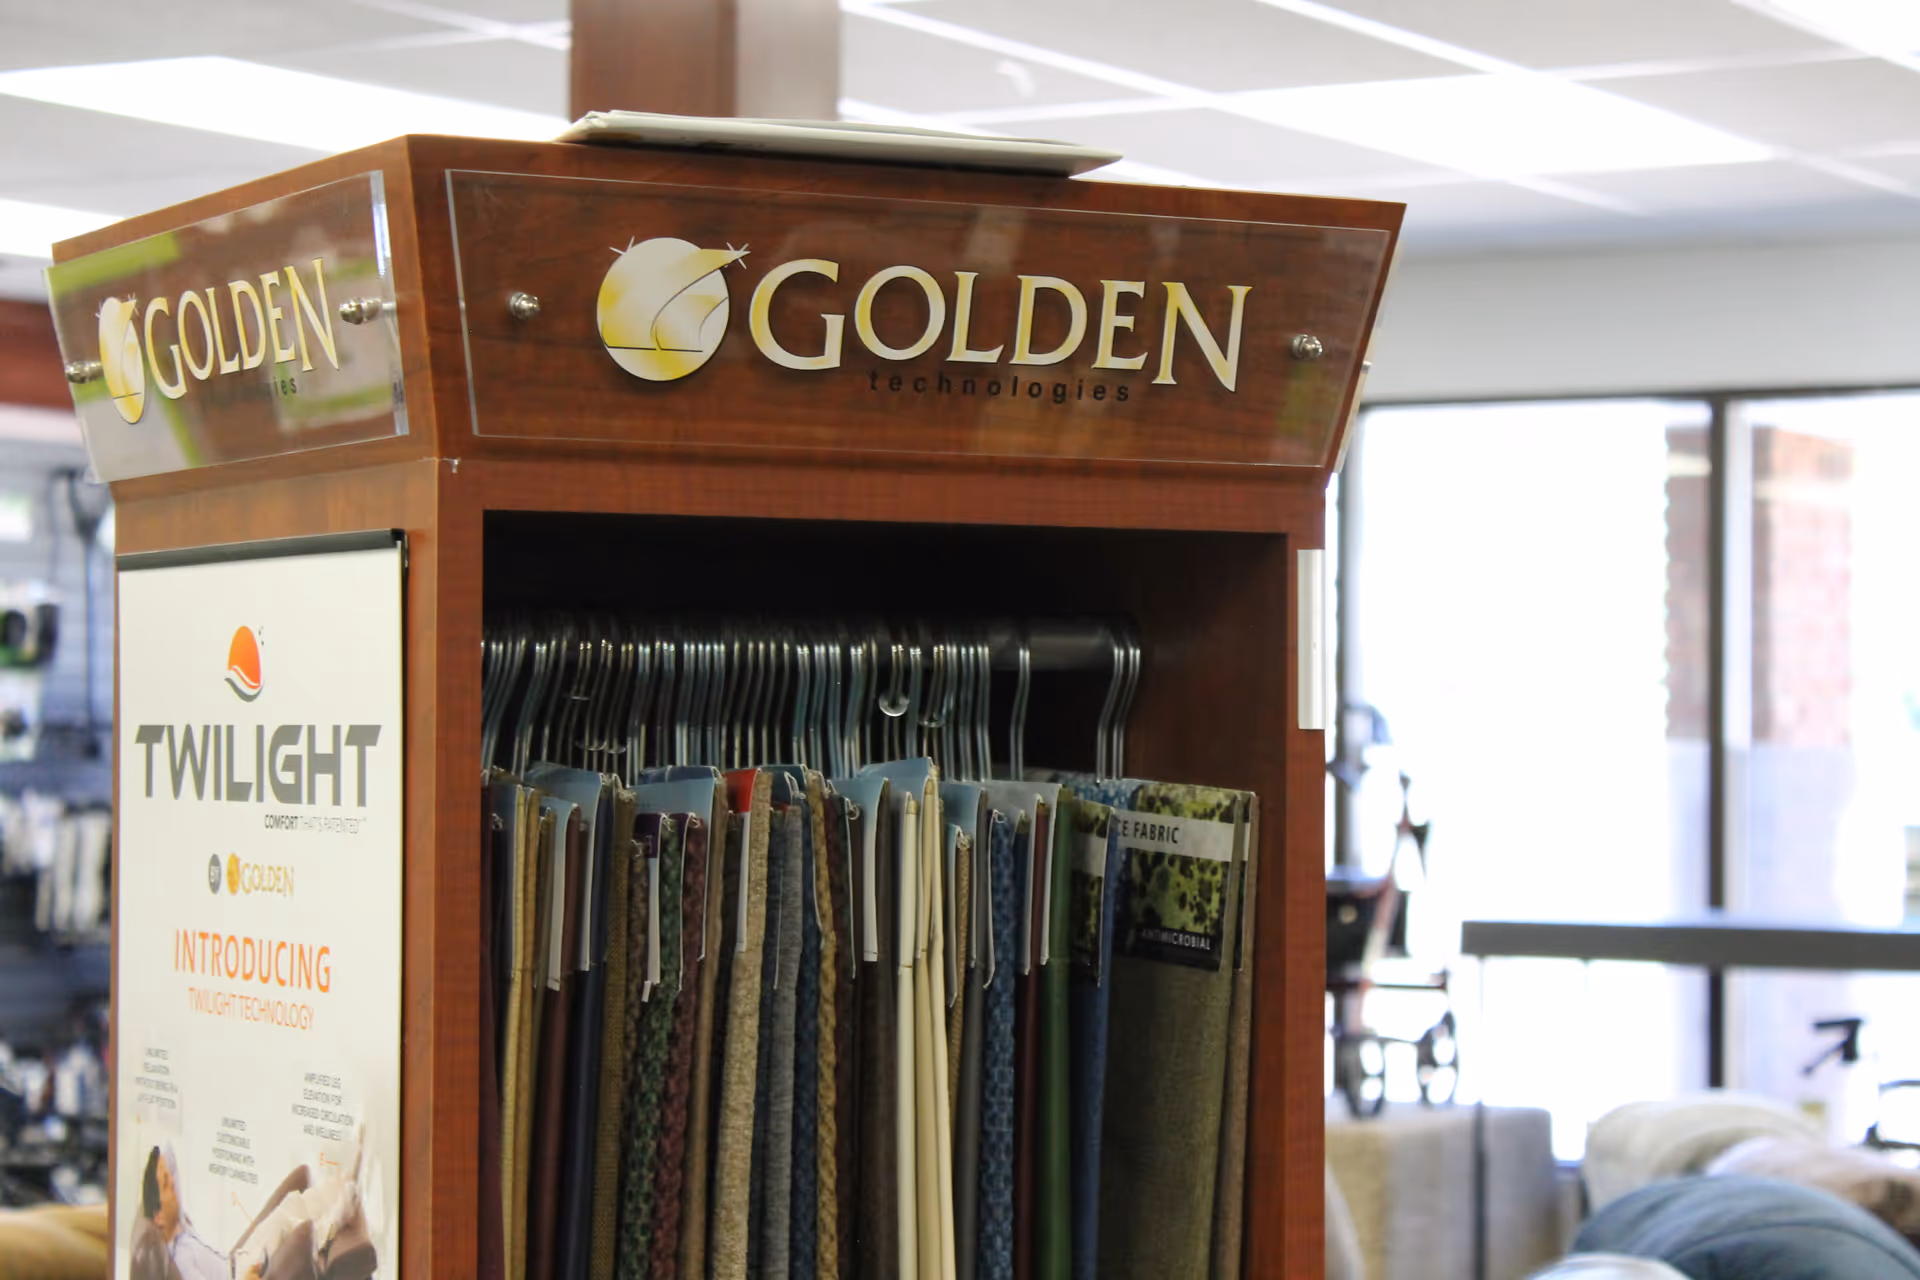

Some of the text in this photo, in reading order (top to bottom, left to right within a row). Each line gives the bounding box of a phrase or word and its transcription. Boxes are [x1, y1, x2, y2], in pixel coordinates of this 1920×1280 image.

[144, 257, 339, 399] GOLDEN
[748, 257, 1253, 393] GOLDEN
[869, 369, 1131, 405] technologies
[134, 723, 382, 808] TWILIGHT
[264, 814, 298, 830] COMFORT
[1134, 821, 1180, 845] FABRIC
[241, 861, 295, 898] GOLDEN
[174, 928, 331, 994] INTRODUCING
[188, 987, 315, 1032] TWILIGHT TECHNOLOGY
